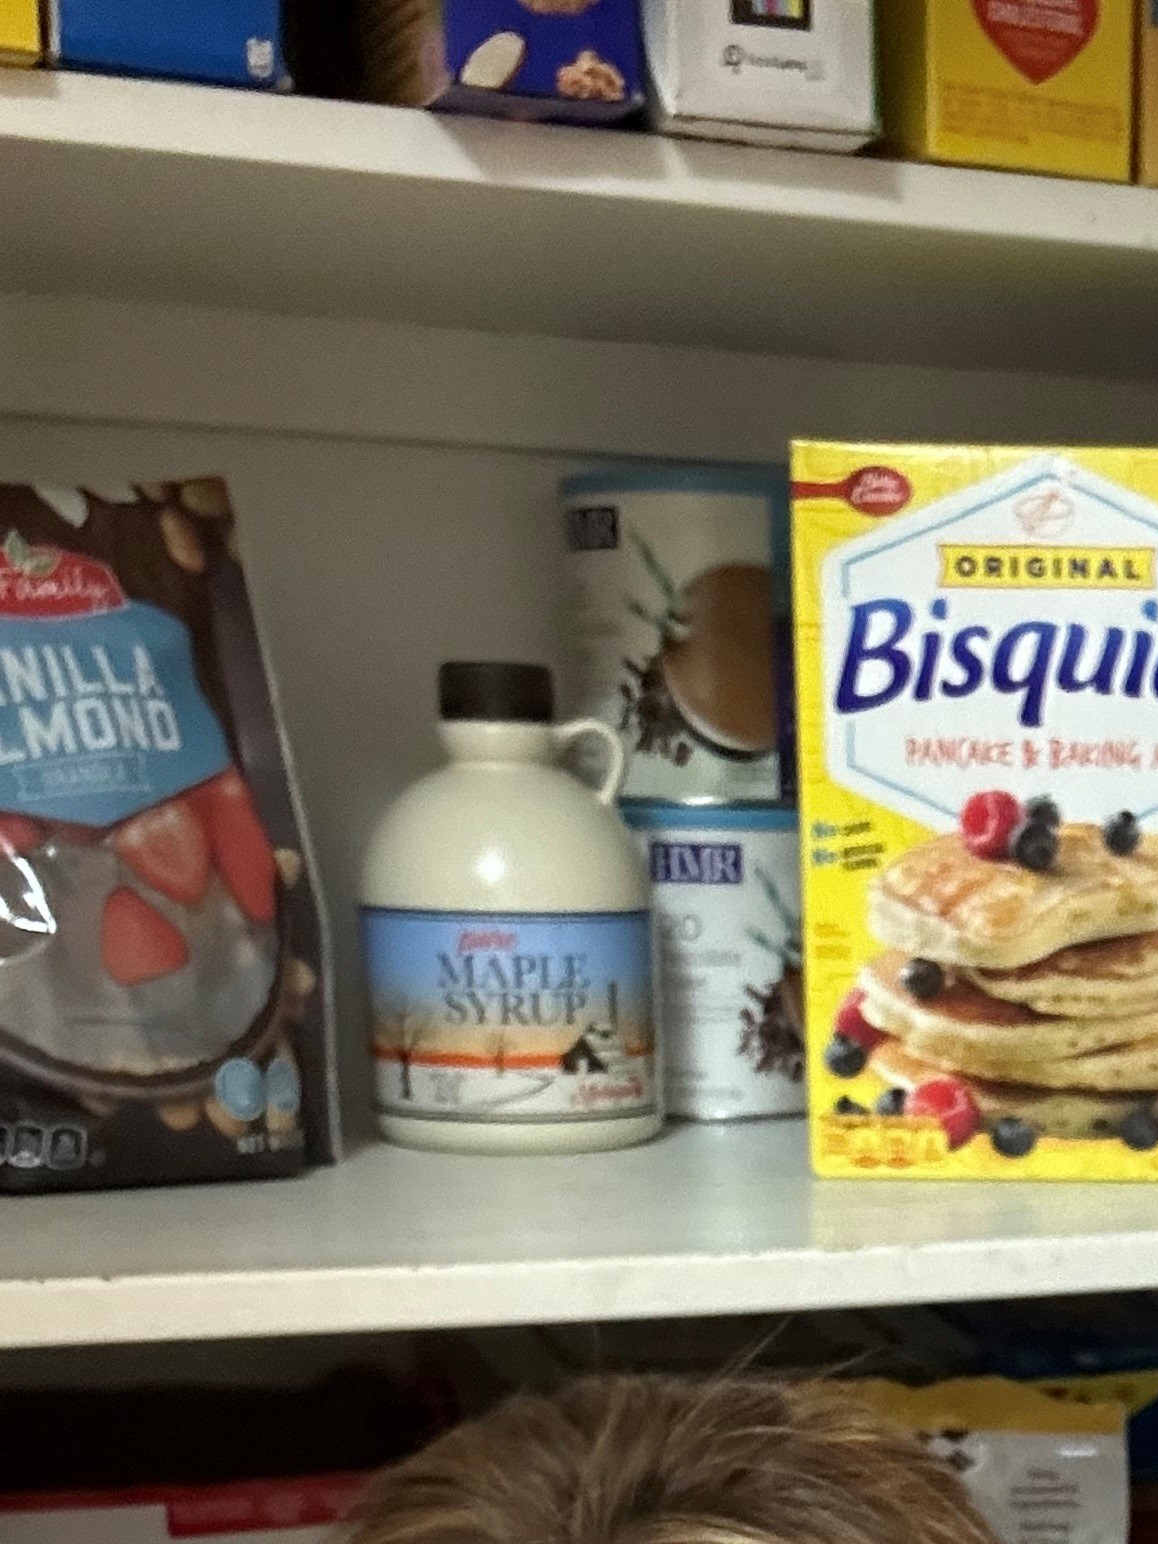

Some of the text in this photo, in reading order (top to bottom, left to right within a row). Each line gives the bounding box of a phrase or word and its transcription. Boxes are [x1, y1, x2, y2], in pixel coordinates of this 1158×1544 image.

[954, 556, 1144, 582] ORIGINAL
[0, 645, 166, 702] NILLA
[437, 950, 590, 990] MAPLE
[444, 988, 586, 1026] SYRUP
